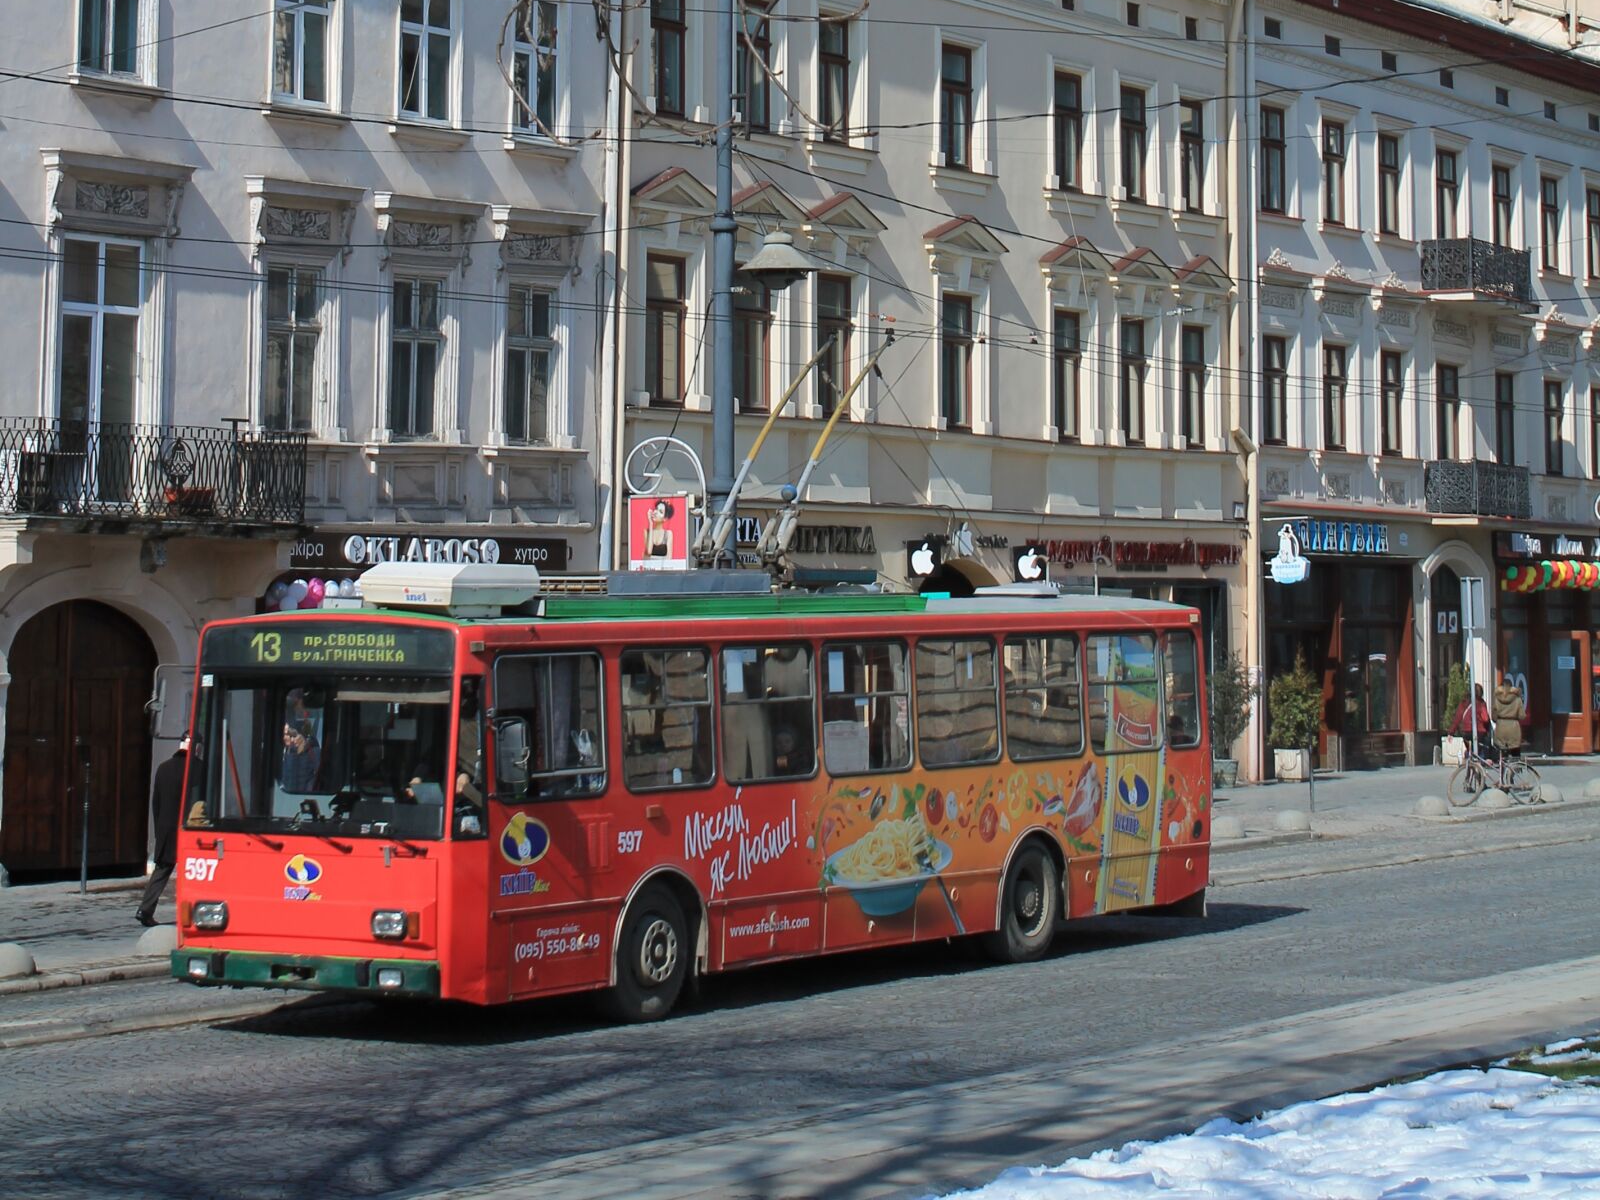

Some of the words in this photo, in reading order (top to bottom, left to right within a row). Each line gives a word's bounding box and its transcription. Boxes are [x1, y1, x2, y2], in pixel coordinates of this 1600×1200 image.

[514, 546, 548, 562] хутро
[250, 632, 282, 662] 13
[303, 633, 396, 647] пр.СВОБОДИ
[292, 649, 405, 663] вул.ГРІНЧЕНКА
[617, 830, 643, 854] 597
[184, 857, 218, 881] 597
[514, 941, 544, 963] (095)
